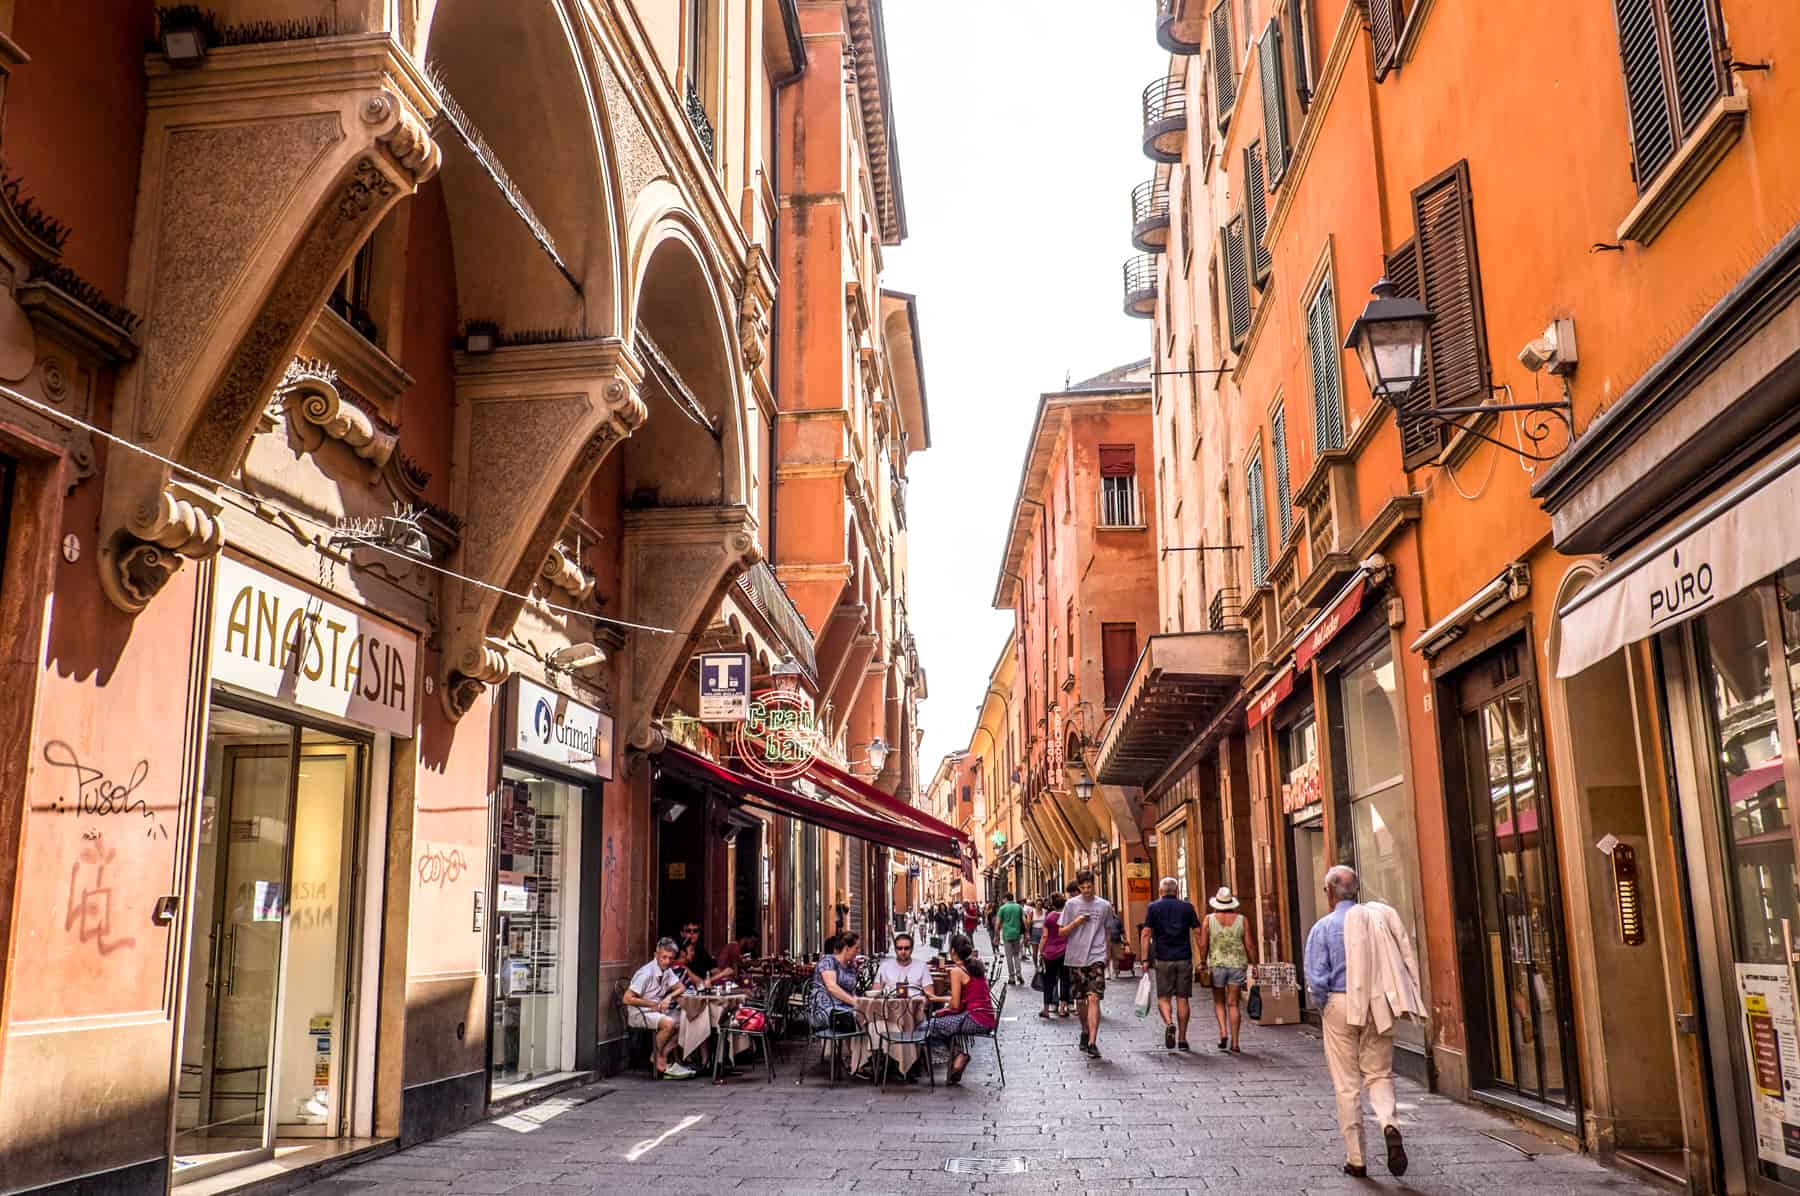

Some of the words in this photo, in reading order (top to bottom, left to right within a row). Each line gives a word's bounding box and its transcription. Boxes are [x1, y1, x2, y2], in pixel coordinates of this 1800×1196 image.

[1650, 562, 1713, 621] PURO
[225, 585, 406, 712] ANASTASIA
[705, 657, 743, 689] T
[555, 712, 602, 758] Grimaldi
